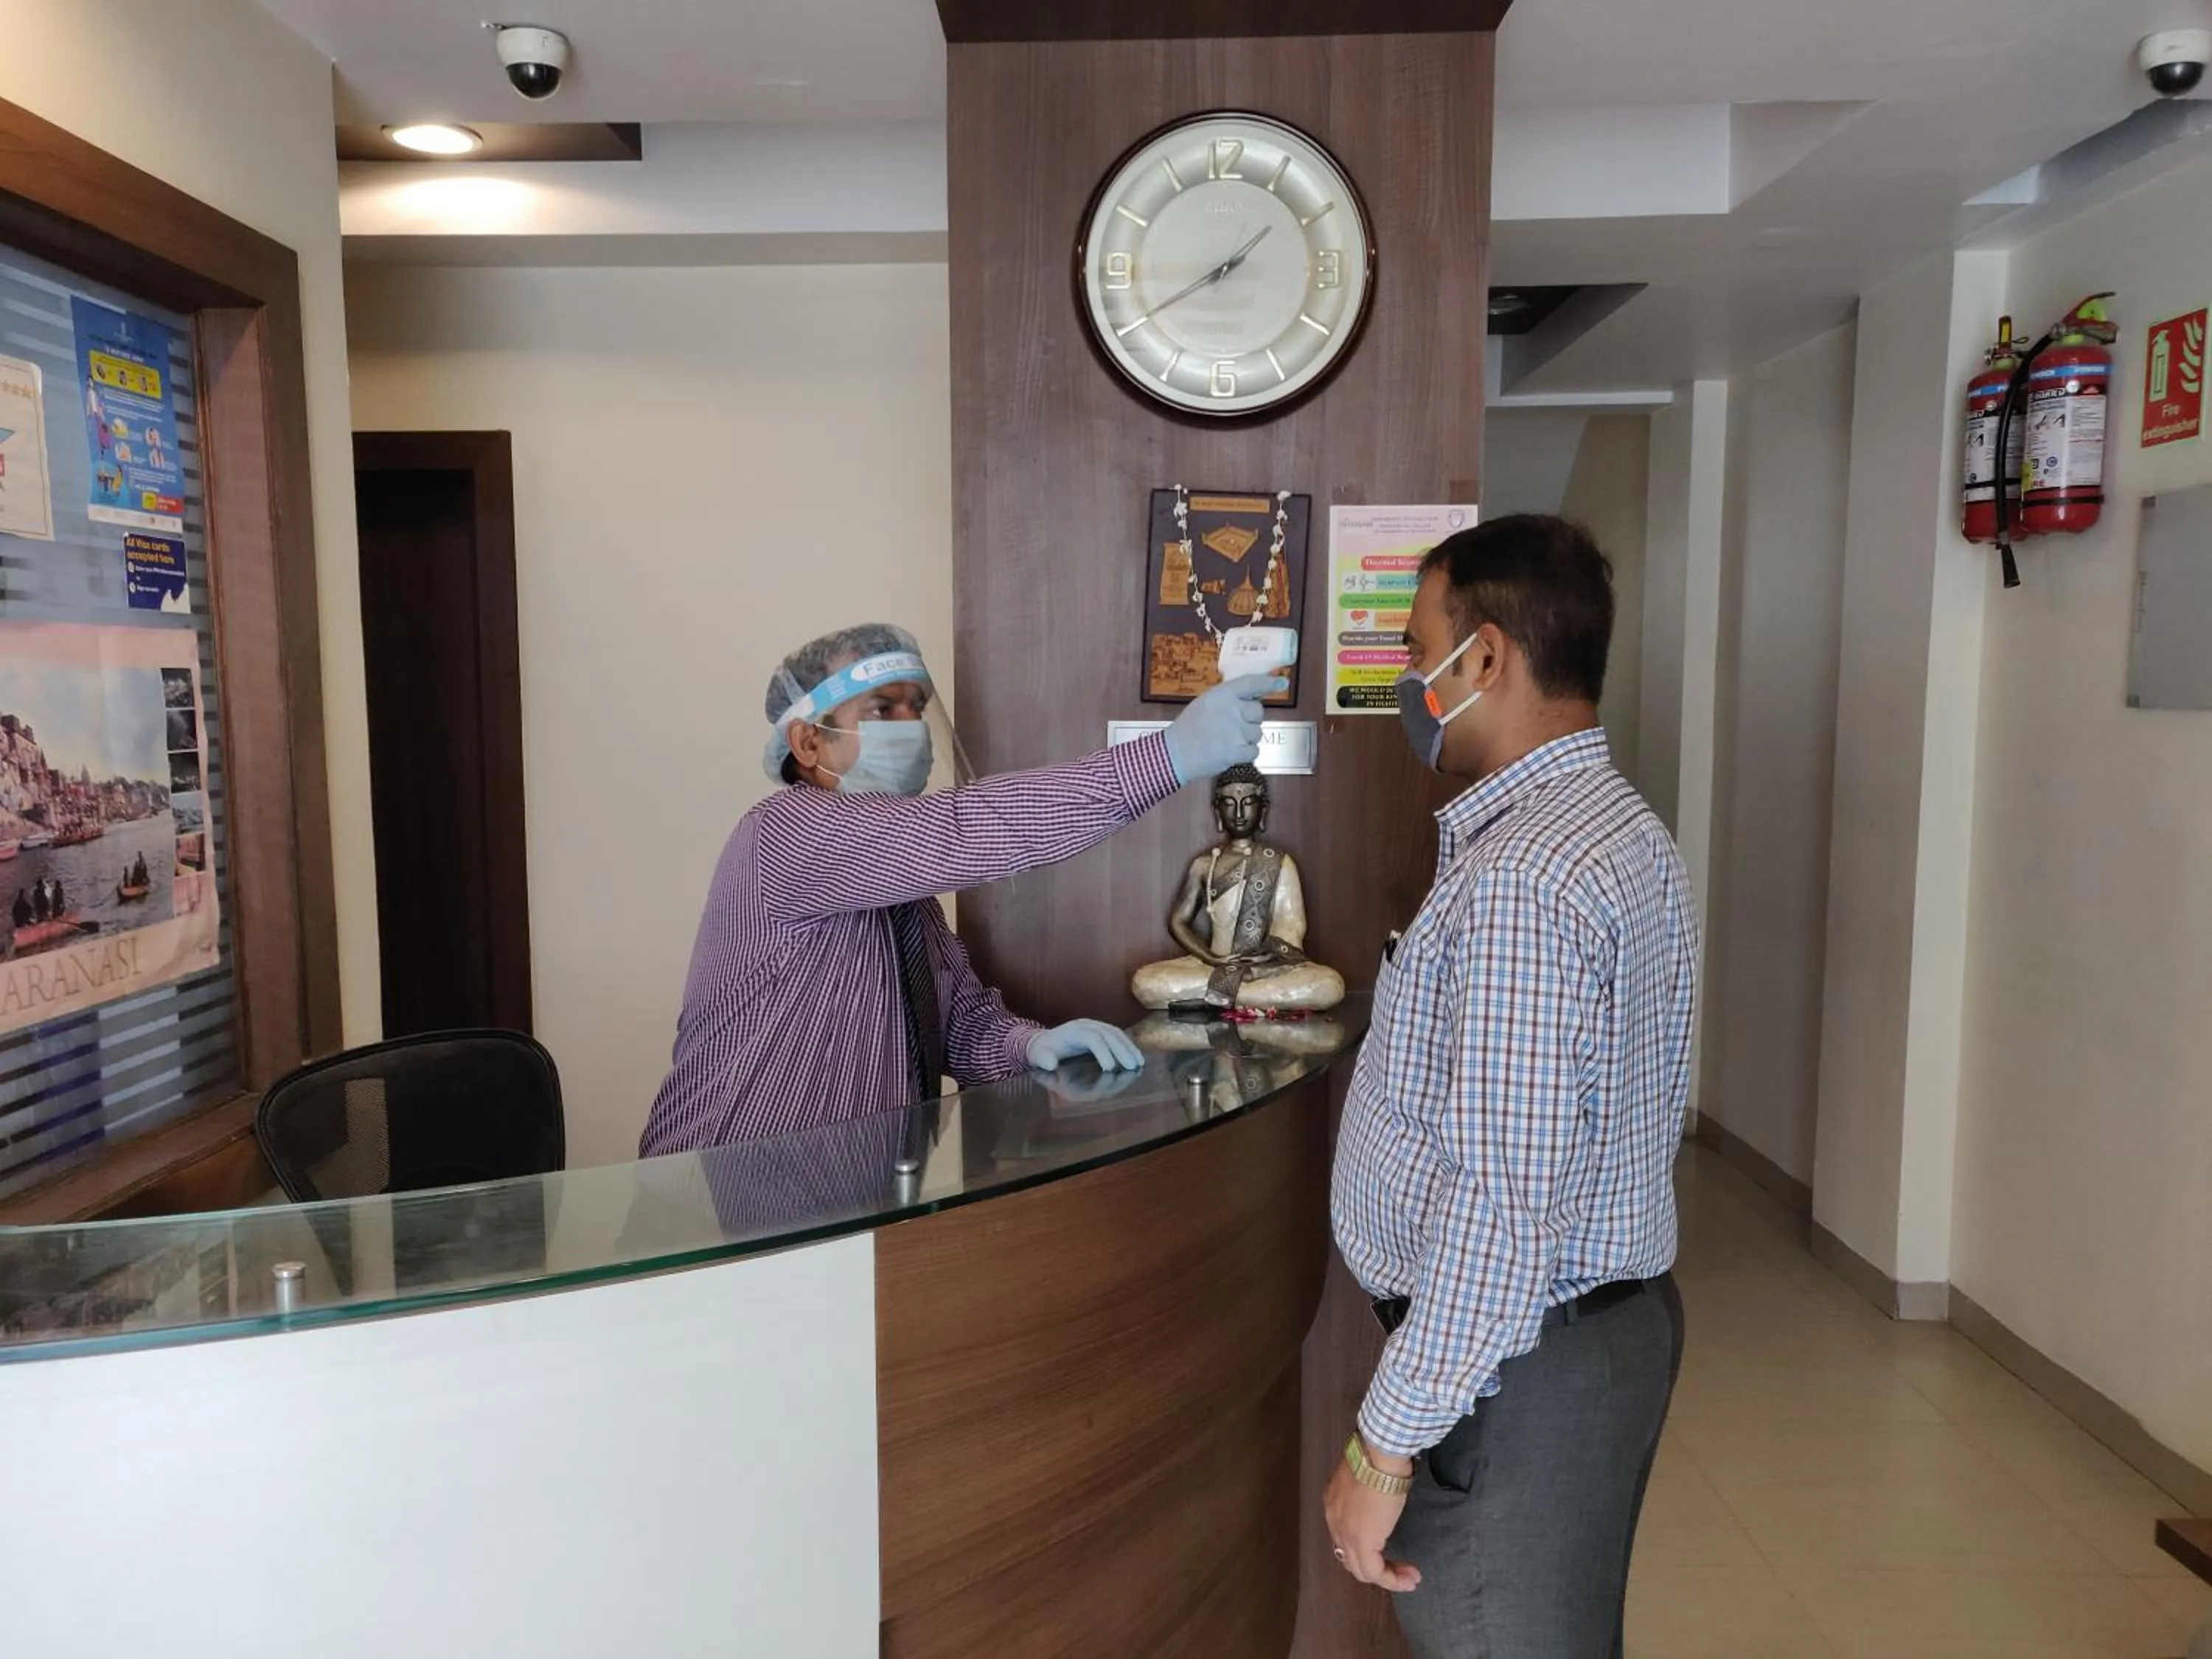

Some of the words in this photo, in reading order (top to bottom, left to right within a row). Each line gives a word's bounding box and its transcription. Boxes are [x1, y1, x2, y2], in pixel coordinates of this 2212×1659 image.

[1207, 138, 1244, 180] 12
[1106, 251, 1133, 290] 9
[1316, 249, 1343, 290] 3
[1209, 360, 1236, 397] 6
[1262, 731, 1287, 745] ME
